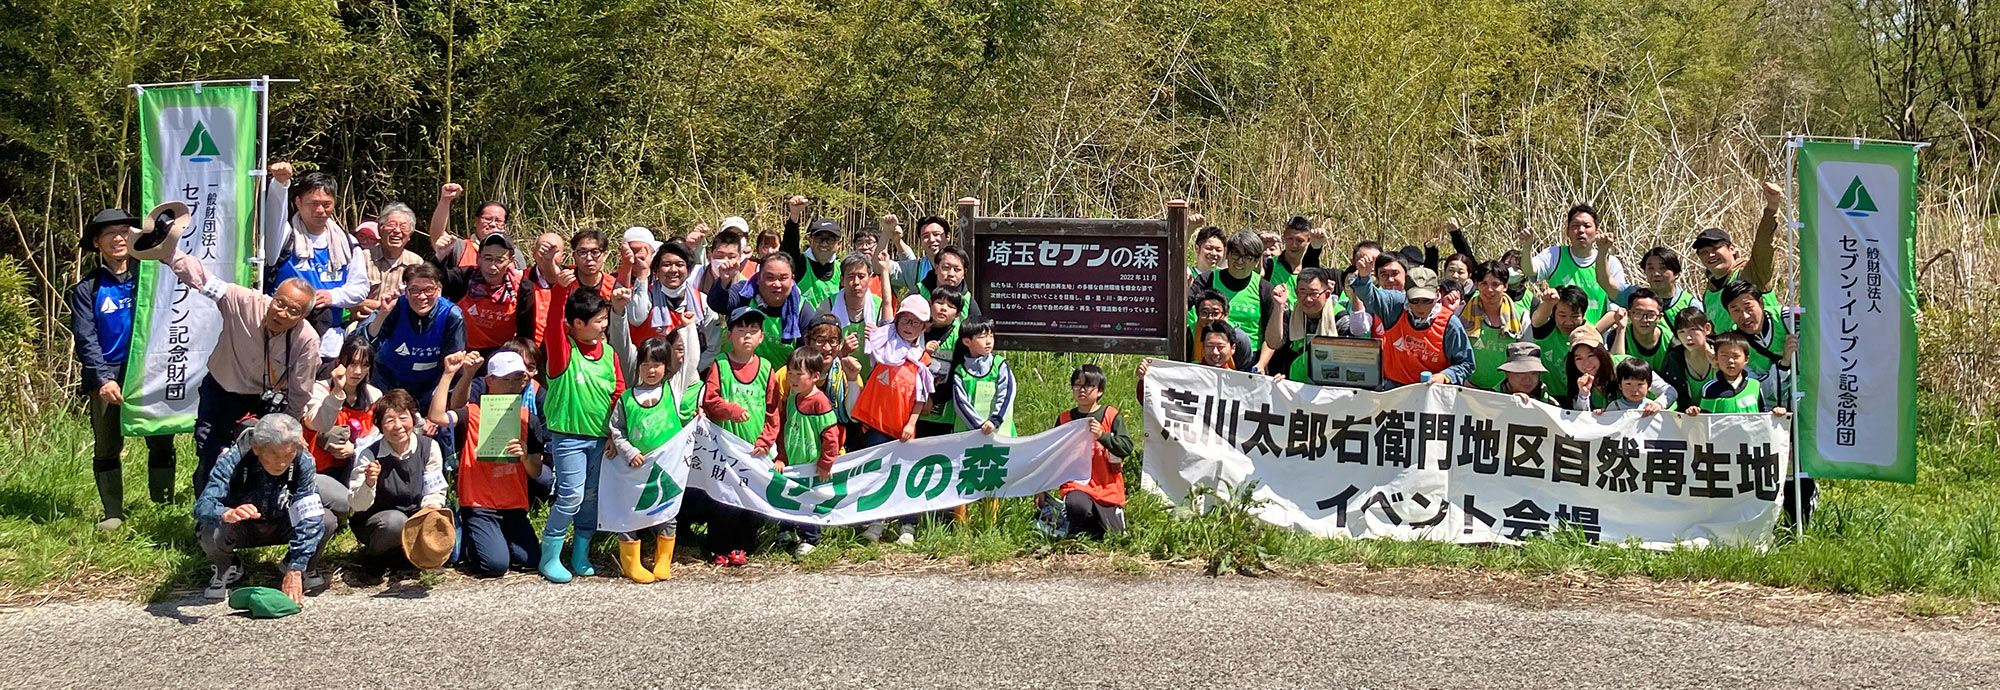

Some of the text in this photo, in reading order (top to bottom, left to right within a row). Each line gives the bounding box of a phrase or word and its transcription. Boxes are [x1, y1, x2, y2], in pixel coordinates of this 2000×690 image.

[201, 183, 218, 260] 一般財団法人
[987, 240, 1159, 269] 埼玉セブンの森
[166, 183, 199, 400] セブン-ブン記念財団
[1865, 238, 1882, 313] 一般財団法人
[1836, 235, 1860, 446] セブン-イレブン記念財団
[766, 444, 1011, 514] セブンの森
[1160, 387, 1779, 501] 荒川太郎右衛門地区自然再生地
[1316, 484, 1602, 546] イベント会場
